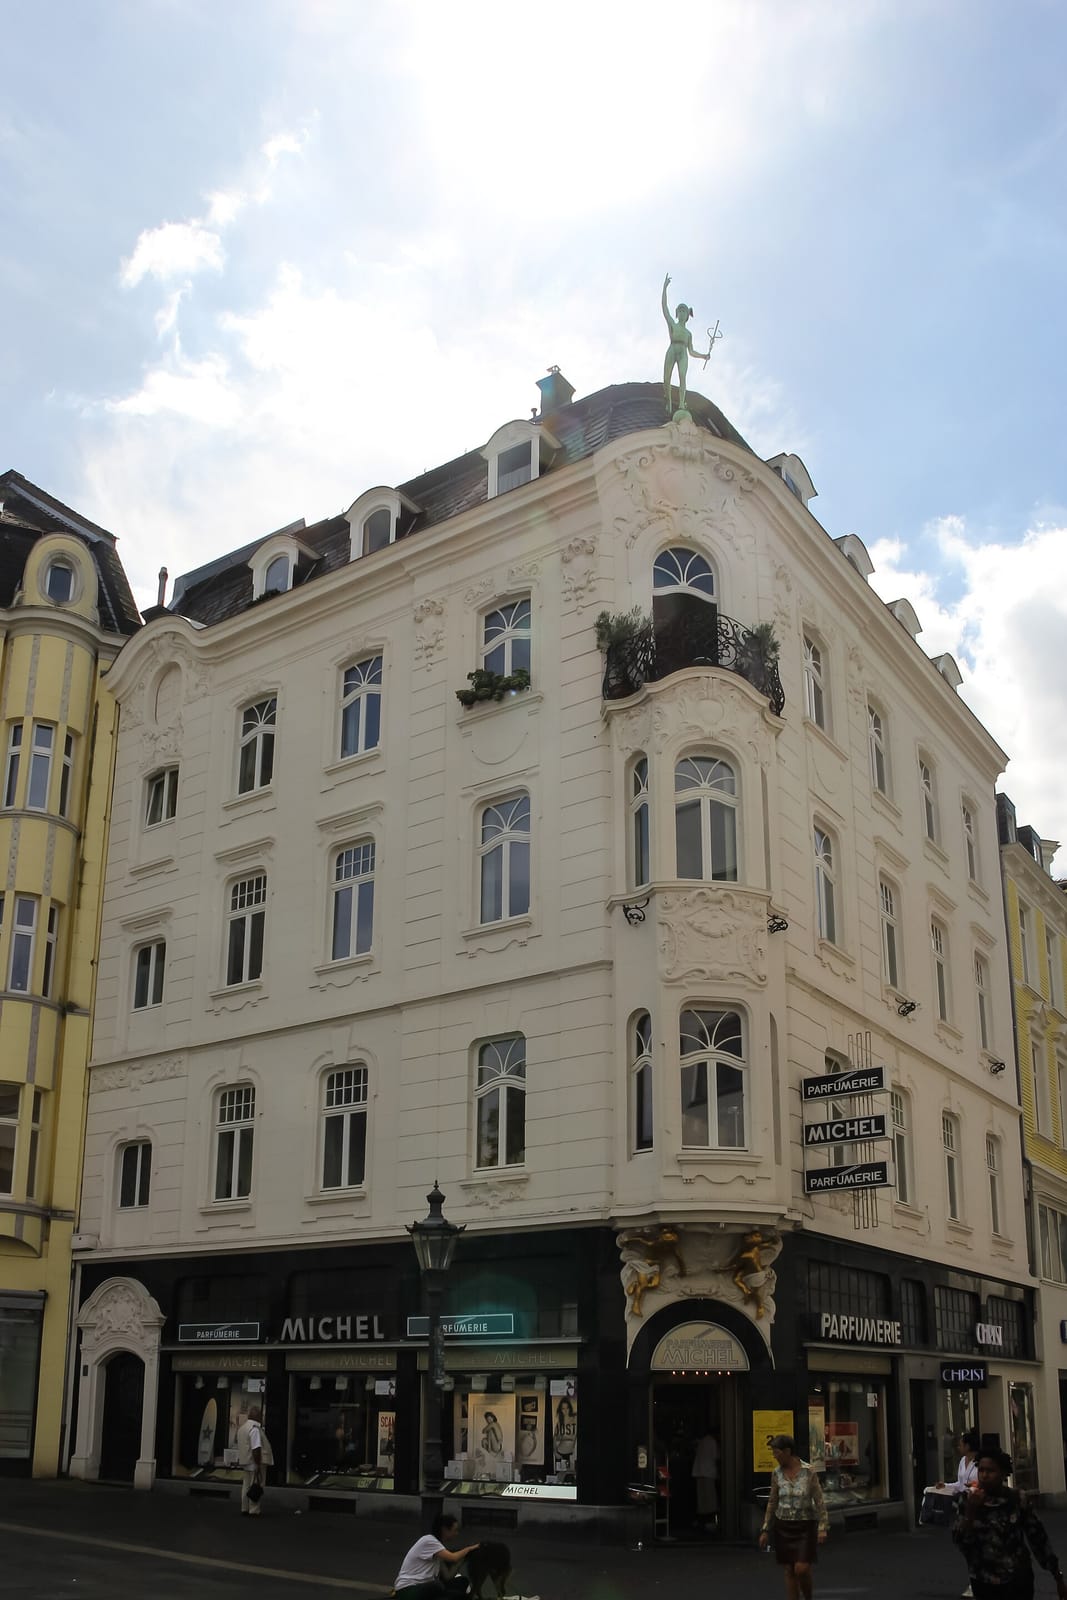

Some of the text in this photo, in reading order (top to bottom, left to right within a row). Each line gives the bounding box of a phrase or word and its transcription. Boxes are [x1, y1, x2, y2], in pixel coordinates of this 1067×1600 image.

[808, 1118, 882, 1142] MICHEL
[280, 1315, 385, 1341] MICHEL
[820, 1312, 902, 1344] PARFUMERIE
[976, 1322, 1003, 1346] CHRIST
[218, 1354, 265, 1368] MICHEL
[339, 1352, 393, 1368] MICHEL
[494, 1351, 557, 1364] MICHEL
[660, 1349, 739, 1365] MICHEL
[942, 1368, 985, 1382] CHRIST
[504, 1486, 539, 1495] MICHEL
